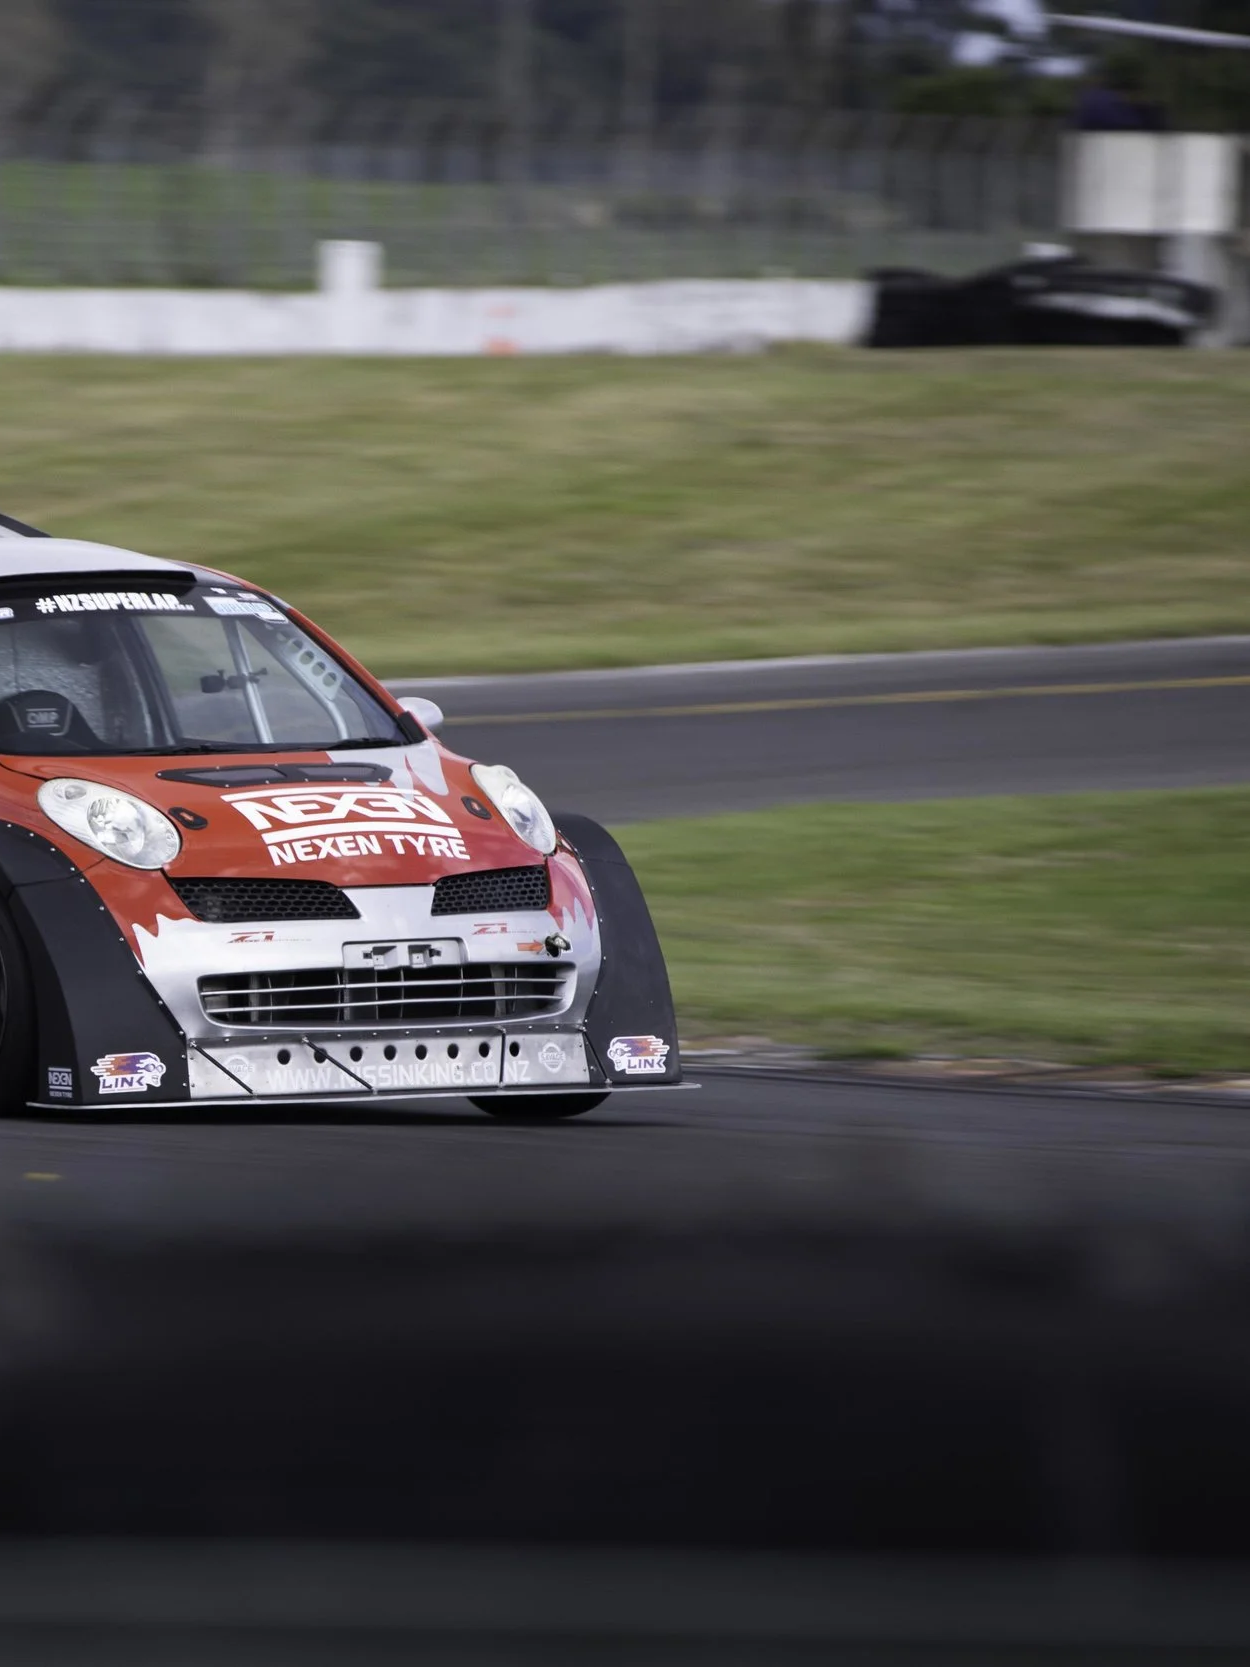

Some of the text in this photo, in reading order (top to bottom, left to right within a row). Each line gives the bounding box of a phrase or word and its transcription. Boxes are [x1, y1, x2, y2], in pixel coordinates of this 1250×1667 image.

[231, 793, 454, 831] NEXEN
[267, 834, 471, 866] NEXEN TYRE
[627, 1058, 664, 1069] LINK
[101, 1076, 145, 1089] LINK
